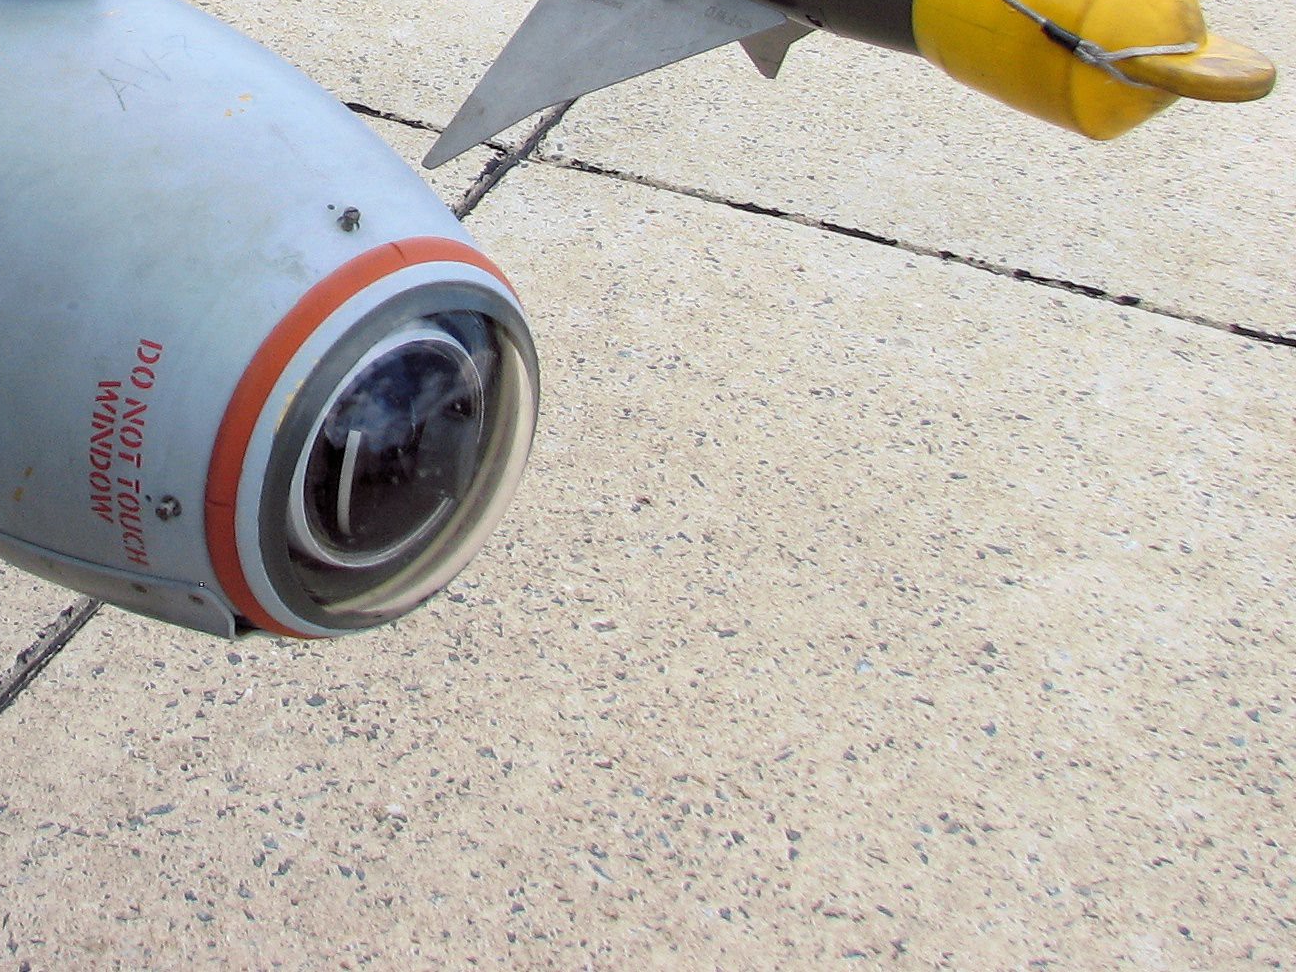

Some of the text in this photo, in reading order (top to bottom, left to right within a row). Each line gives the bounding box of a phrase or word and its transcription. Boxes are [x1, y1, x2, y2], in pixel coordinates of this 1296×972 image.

[89, 381, 121, 524] WINDOW
[117, 339, 162, 565] DO NOT TOUCH
